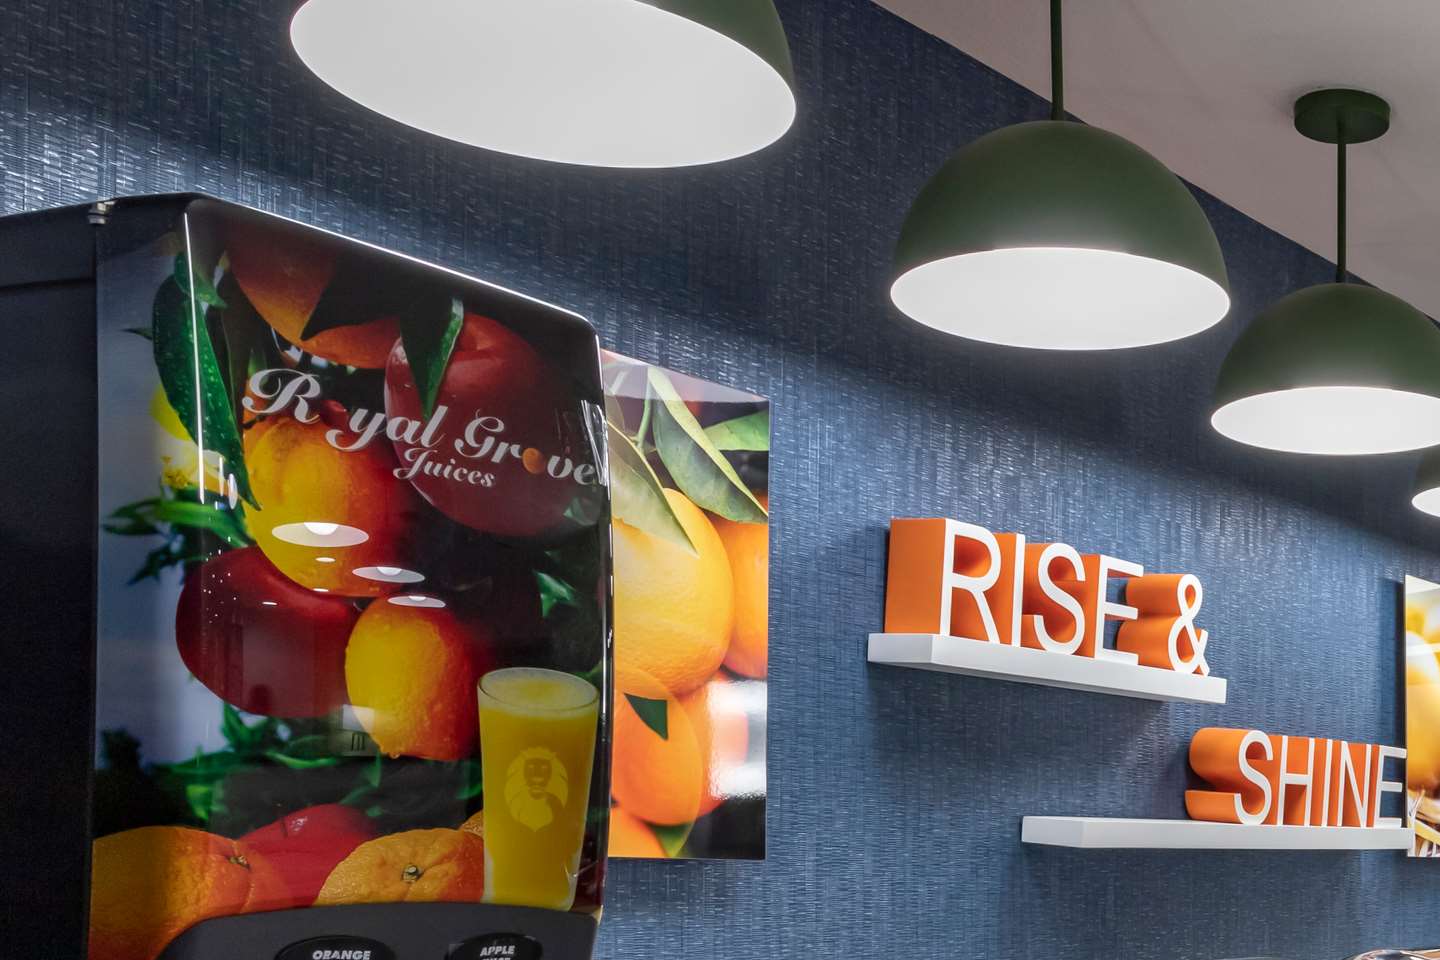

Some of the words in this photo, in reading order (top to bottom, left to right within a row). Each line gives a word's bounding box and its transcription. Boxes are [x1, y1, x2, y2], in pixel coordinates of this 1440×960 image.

[242, 368, 448, 450] Royal
[393, 448, 496, 488] Juices
[936, 517, 1146, 665] RISE
[1160, 573, 1211, 676] &
[1232, 728, 1407, 828] SHINE
[312, 950, 371, 960] ORANGE
[480, 945, 515, 956] APPLE
